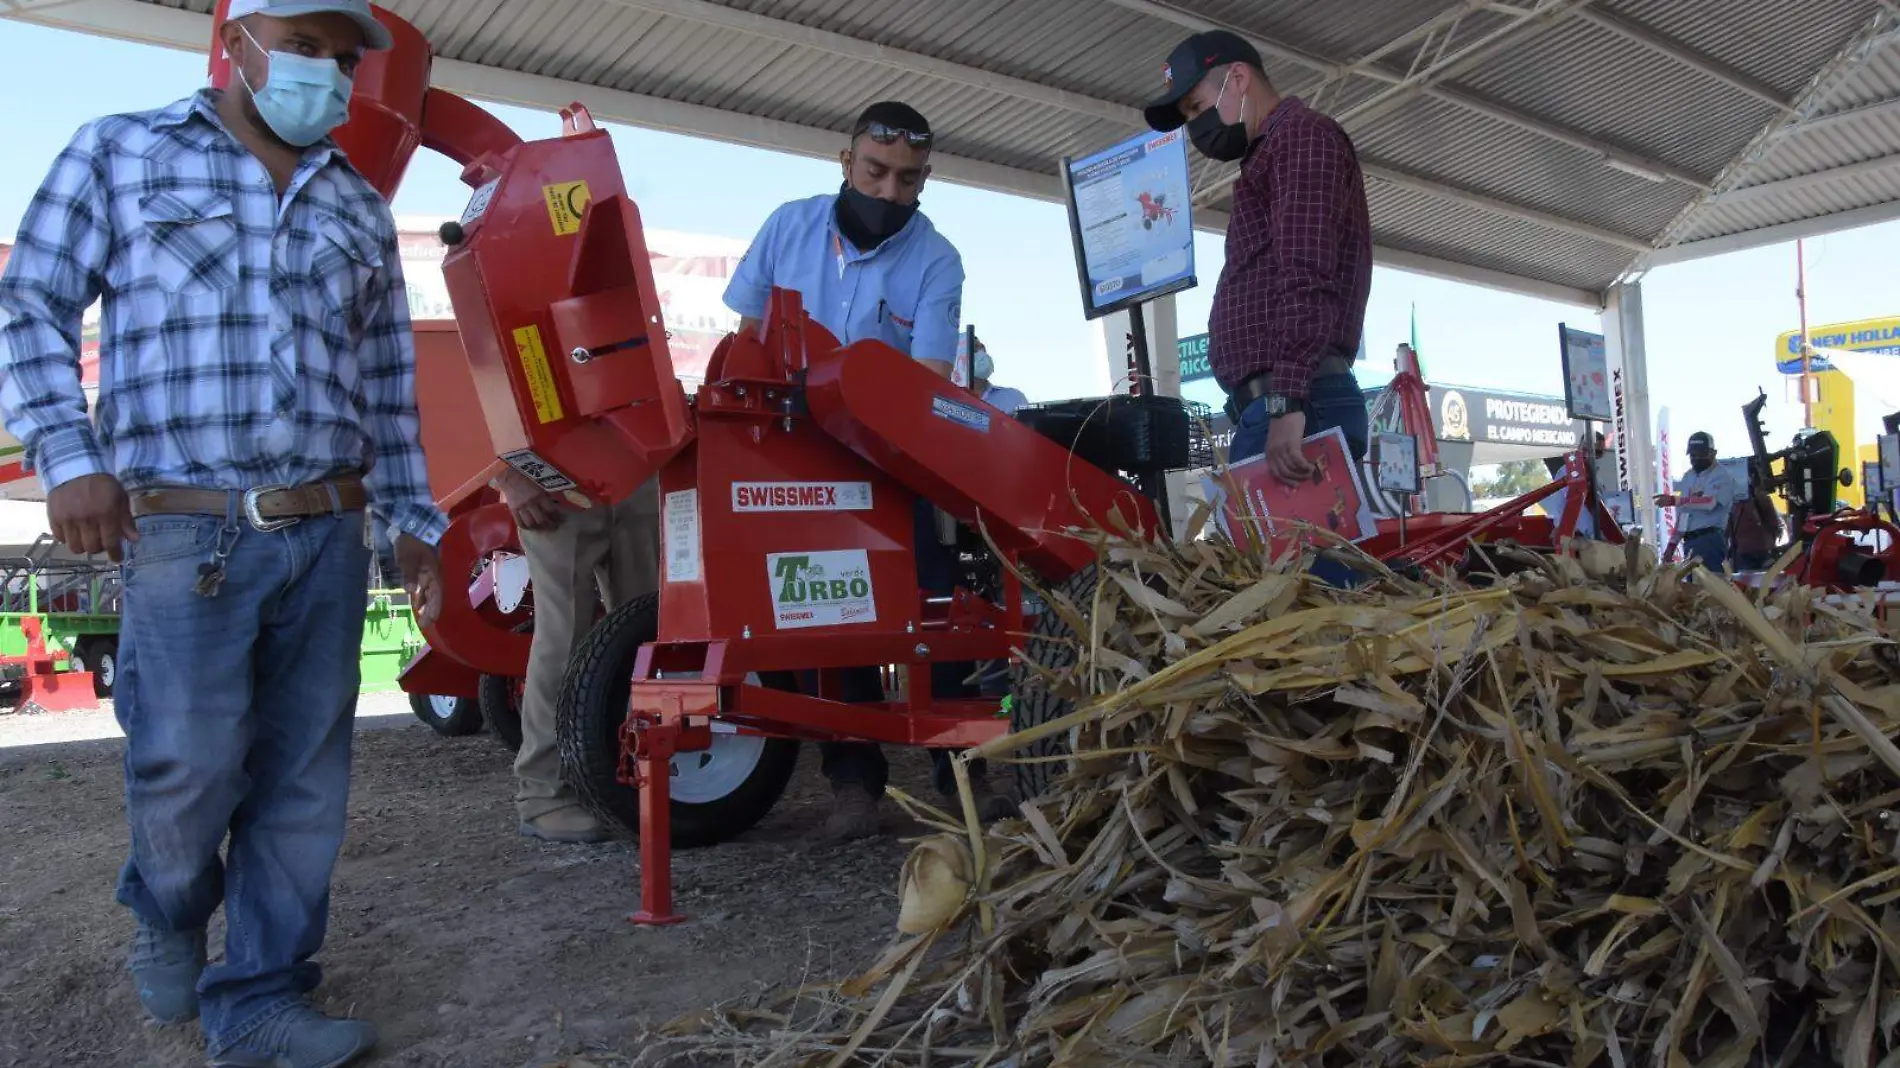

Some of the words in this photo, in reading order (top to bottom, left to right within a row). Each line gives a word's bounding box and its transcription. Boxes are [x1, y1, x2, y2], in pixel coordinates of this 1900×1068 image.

[1811, 333, 1847, 348] NEW
[1486, 398, 1573, 426] PROTEGIENDO
[1487, 425, 1498, 440] EL
[1500, 427, 1532, 442] CAMPO
[1532, 428, 1576, 446] MEXICANO
[1613, 367, 1629, 492] SWISSMEX
[736, 486, 837, 508] SWISSMEX
[774, 555, 869, 603] TURBO
